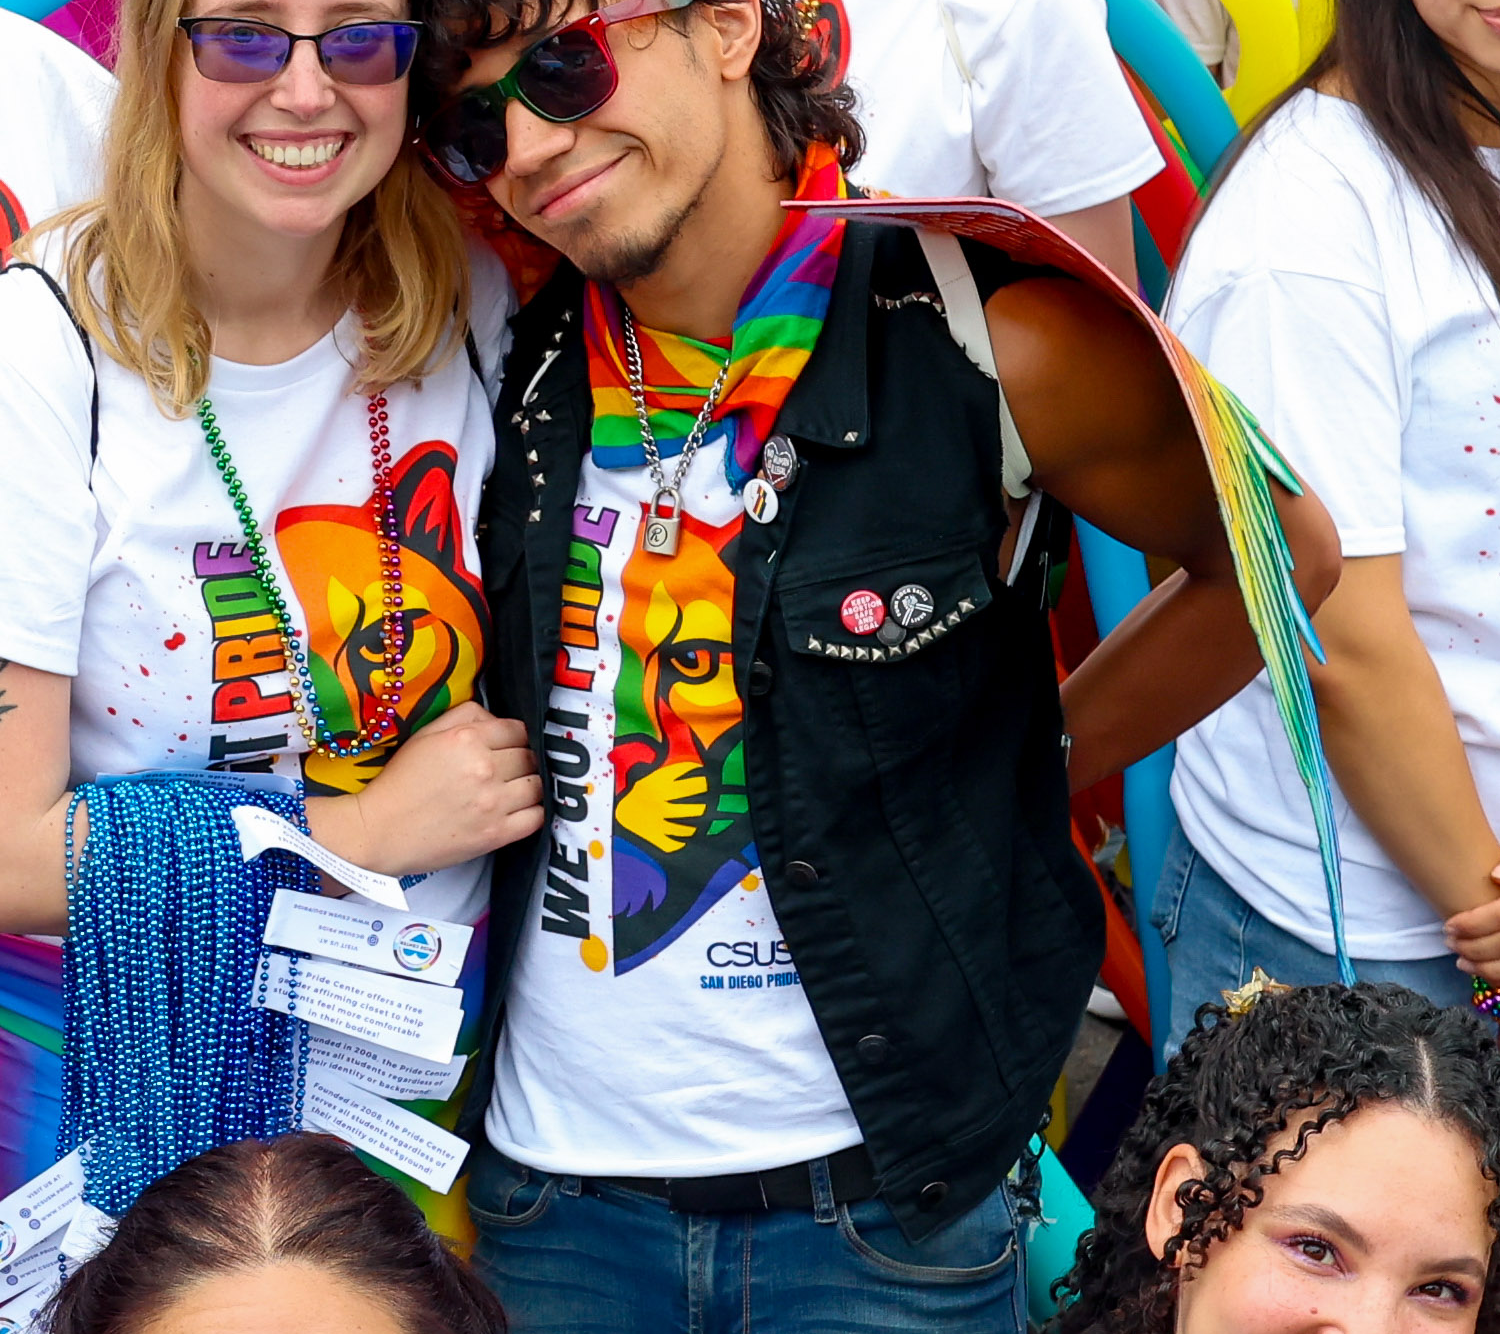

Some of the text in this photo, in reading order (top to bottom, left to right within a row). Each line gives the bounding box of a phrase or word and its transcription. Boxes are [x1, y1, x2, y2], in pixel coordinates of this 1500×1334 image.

[843, 598, 883, 616] ABORTION
[851, 595, 871, 607] KEEP
[912, 588, 928, 602] SAVES
[193, 539, 298, 726] PRIDE
[854, 621, 879, 634] LEGAL
[858, 616, 874, 625] AND
[911, 612, 927, 624] LIVES
[541, 503, 620, 941] WE GOT PRIDE
[306, 970, 330, 984] Pride
[333, 980, 364, 996] Center
[367, 991, 394, 1006] offers
[405, 1003, 423, 1015] free
[700, 971, 801, 990] SAN DIEGO PRIDE
[308, 1008, 380, 1039] in their bodies!
[313, 986, 424, 1027] affirming closet to help
[317, 998, 421, 1038] feel more comfortable
[328, 1062, 365, 1080] identity
[368, 1076, 377, 1084] or
[332, 1052, 345, 1062] all
[346, 1057, 386, 1077] students
[388, 1071, 433, 1087] regardless
[343, 1042, 352, 1051] in
[382, 1058, 398, 1069] the
[400, 1064, 423, 1077] Pride
[425, 1069, 452, 1078] Center
[311, 1094, 447, 1170] serves all students regardless of
[313, 1082, 349, 1105] Founded
[351, 1100, 360, 1109] in
[385, 1118, 401, 1131] the
[401, 1126, 424, 1143] Pride
[426, 1141, 456, 1162] Center
[311, 1106, 433, 1176] their identity or background!
